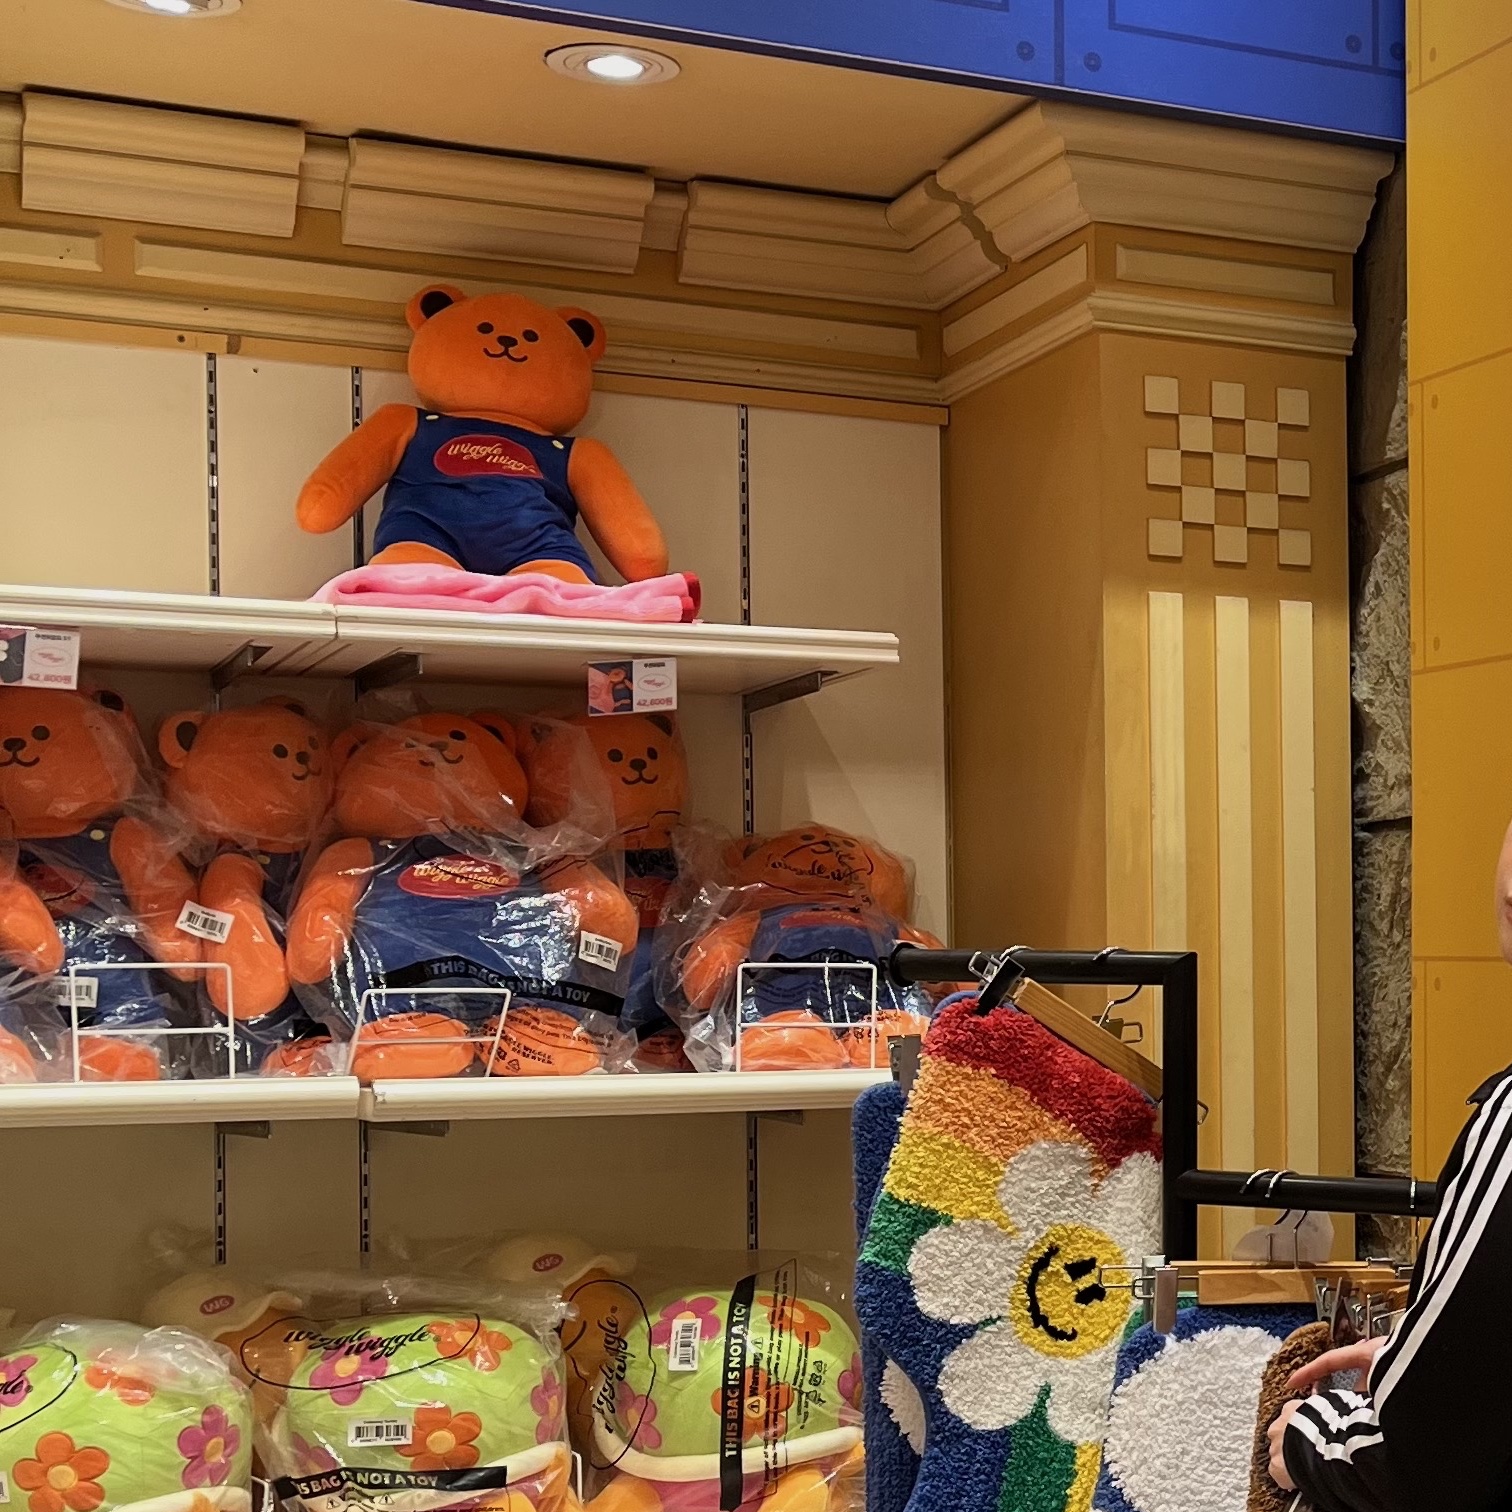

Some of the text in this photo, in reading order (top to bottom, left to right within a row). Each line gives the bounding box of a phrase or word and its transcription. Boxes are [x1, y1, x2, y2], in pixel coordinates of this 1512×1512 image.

[447, 443, 503, 460] wiggle
[429, 958, 466, 975] THIS
[466, 964, 499, 986] BAG
[551, 982, 565, 997] A
[566, 987, 591, 1003] TOY
[283, 1326, 372, 1351] wiggle
[343, 1324, 432, 1361] wiggle
[730, 1324, 745, 1338] A
[728, 1338, 742, 1369] NOT
[728, 1371, 740, 1385] IS
[726, 1387, 740, 1419] BAG
[725, 1421, 739, 1457] THIS
[312, 1475, 341, 1493] BAG
[357, 1472, 390, 1486] NOT
[394, 1473, 407, 1485] A
[407, 1475, 438, 1487] TOY
